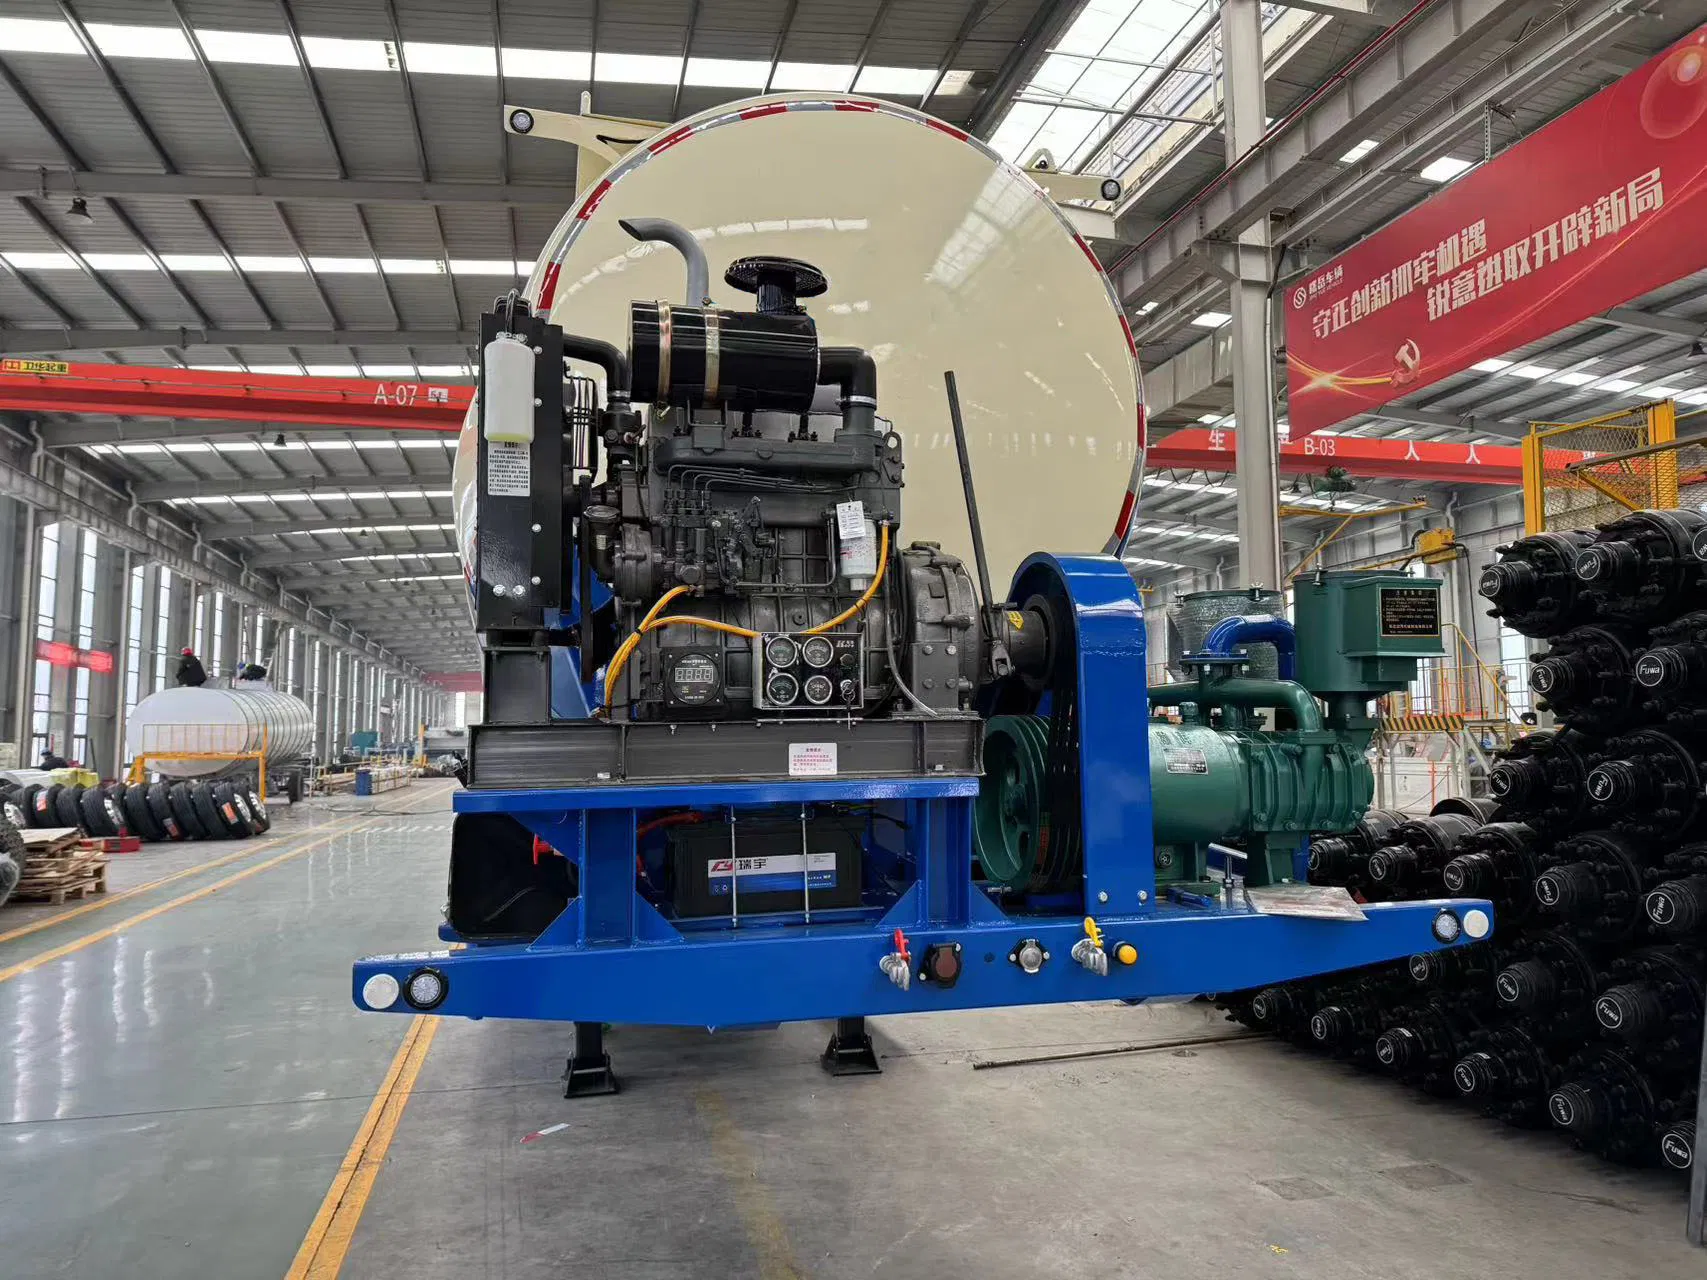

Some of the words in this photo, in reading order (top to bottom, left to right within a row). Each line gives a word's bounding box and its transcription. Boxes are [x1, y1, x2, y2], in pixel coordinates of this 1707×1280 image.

[1426, 167, 1664, 321] 锐意进取开辟新局
[1312, 218, 1488, 339] 守正创新抓牢机遇
[373, 382, 418, 407] A-07
[1304, 437, 1336, 456] B-03
[1536, 669, 1548, 689] Fuwa
[1640, 665, 1660, 675] Fuwa
[1492, 773, 1508, 790] Fuwa
[1594, 775, 1608, 796] Fuwa
[738, 858, 767, 870] 瑞宇
[1653, 896, 1665, 920] Fuwa
[1500, 977, 1515, 996] Fuwa
[1600, 1002, 1619, 1021] Fuwa
[1457, 1067, 1472, 1087] Fuwa
[1555, 1098, 1568, 1121] Fuwa
[1665, 1140, 1688, 1159] Fuwa
